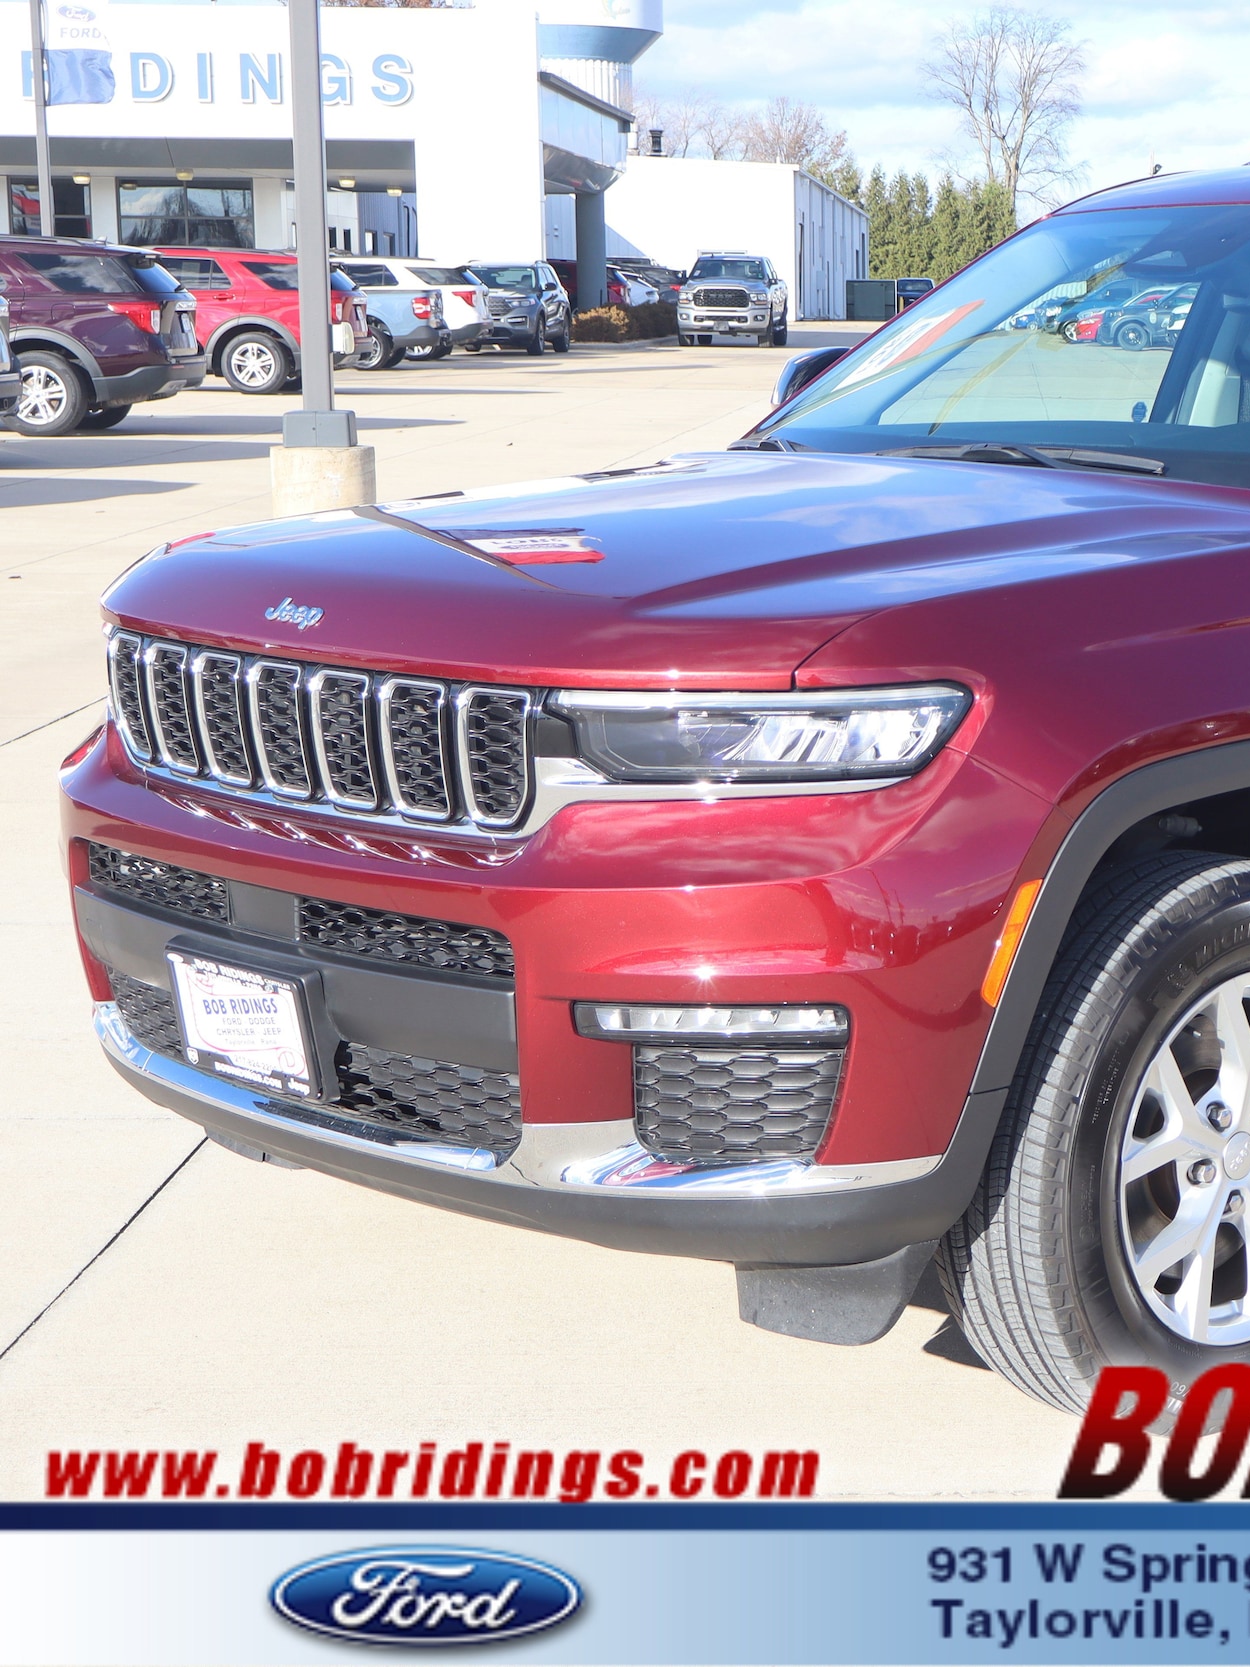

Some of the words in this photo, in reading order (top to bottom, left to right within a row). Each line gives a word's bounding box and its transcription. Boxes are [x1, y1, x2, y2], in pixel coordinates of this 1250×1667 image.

[60, 28, 101, 38] FORD
[21, 50, 411, 104] DINGS
[264, 597, 324, 630] Jeep
[193, 958, 219, 974] BOB
[202, 999, 227, 1015] BOB
[229, 998, 278, 1014] RIDINGS
[222, 1017, 242, 1026] FORD
[249, 1017, 276, 1025] DODGE
[216, 1028, 255, 1036] CHRYSLER
[263, 1028, 282, 1036] JEEP
